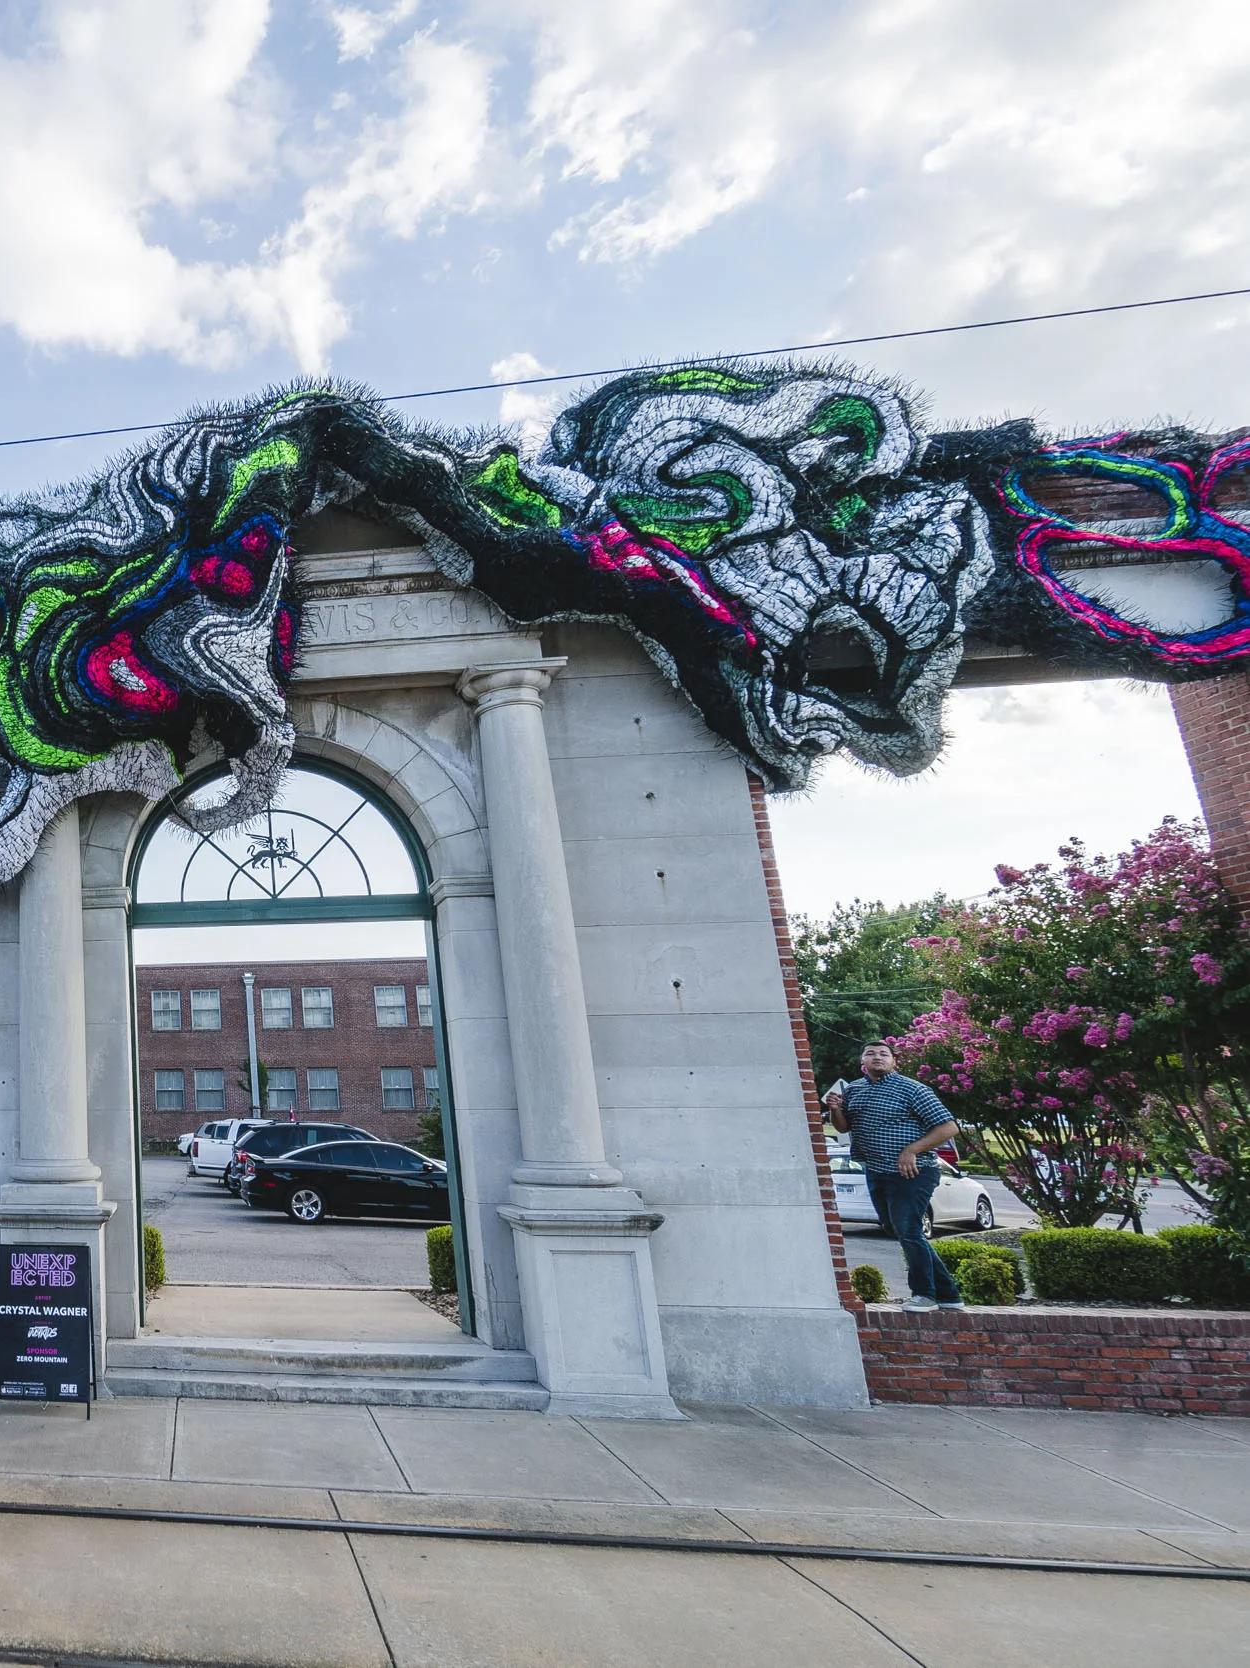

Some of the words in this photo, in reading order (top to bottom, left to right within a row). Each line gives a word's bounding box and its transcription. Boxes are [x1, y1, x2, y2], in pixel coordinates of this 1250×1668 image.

[389, 600, 419, 632] &
[11, 1253, 76, 1270] UNEXP
[10, 1269, 76, 1287] ECTED
[42, 1306, 88, 1317] WAGNER
[26, 1347, 58, 1355] SPONSOR
[16, 1355, 33, 1363] ZERO
[33, 1355, 68, 1364] MOUNTAIN
